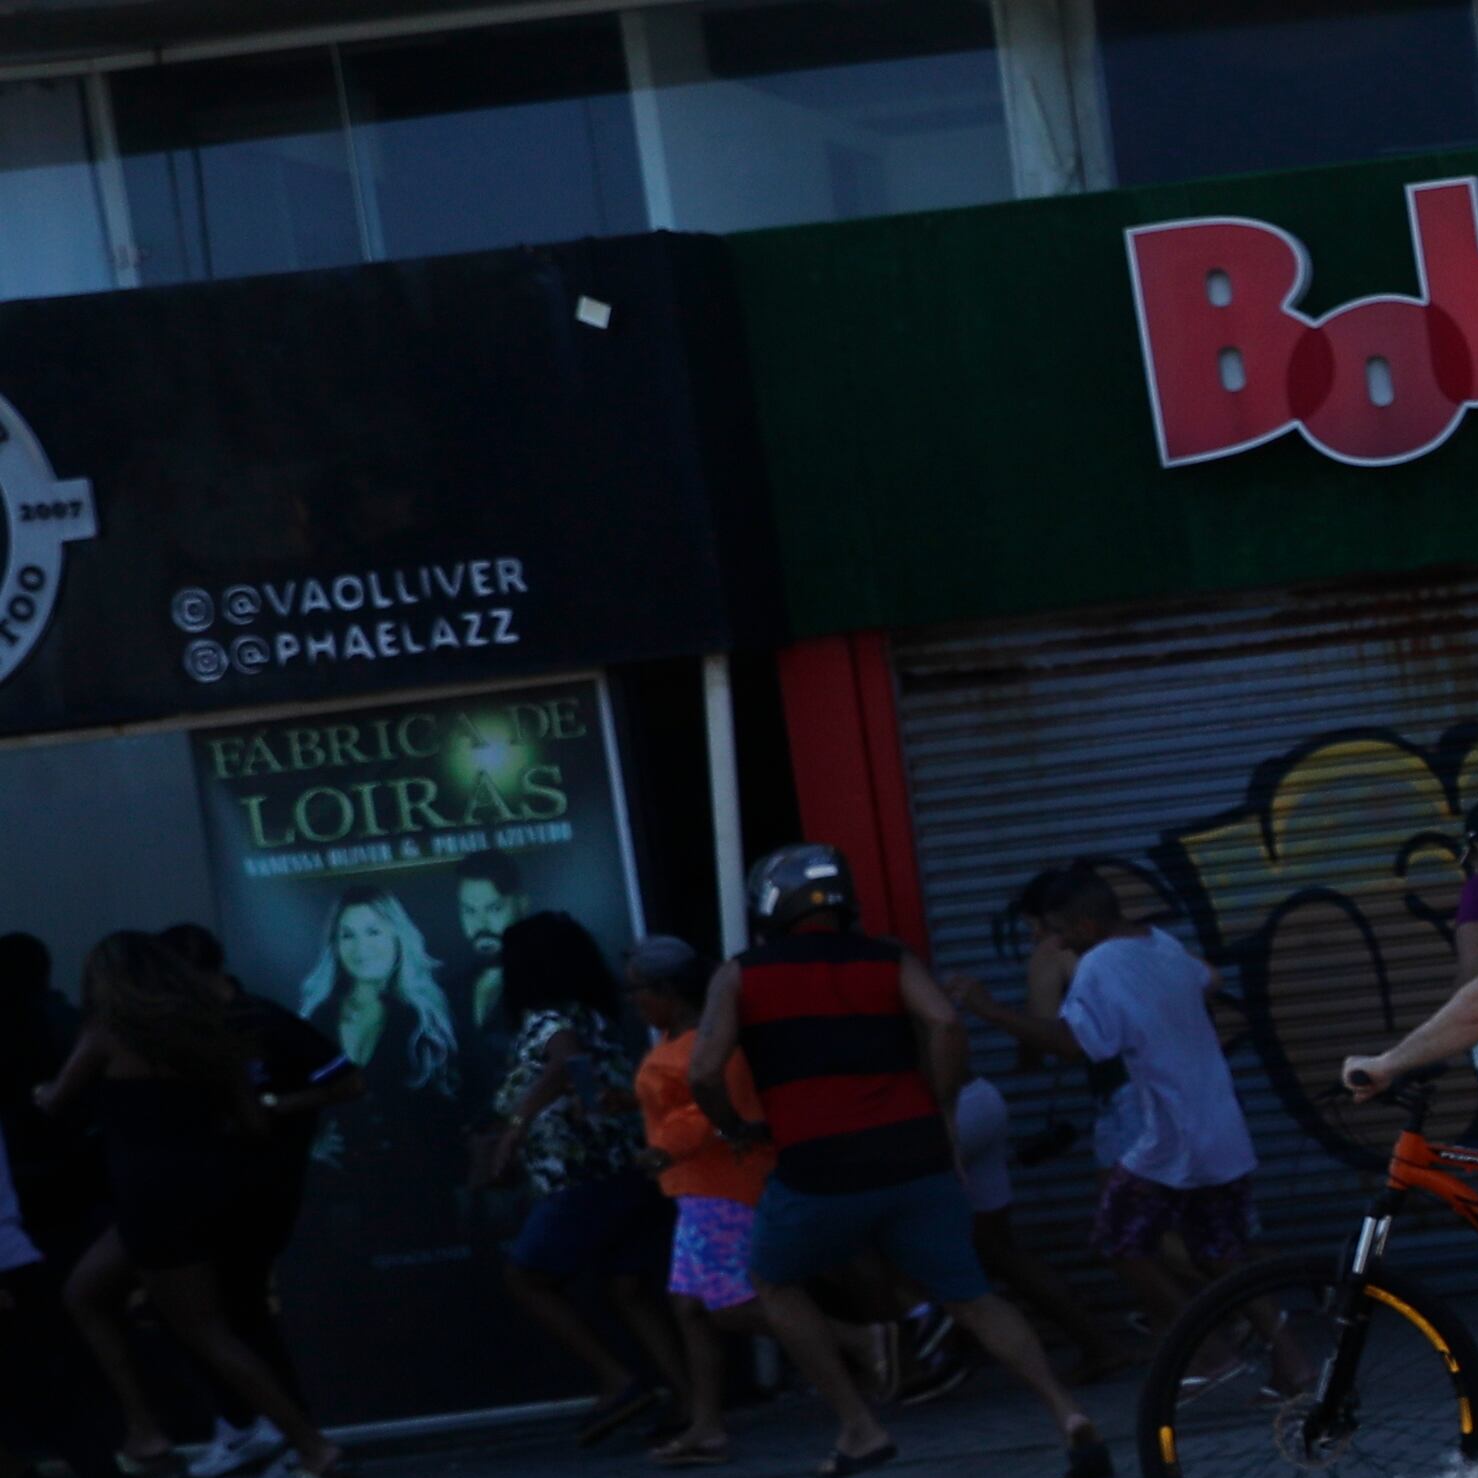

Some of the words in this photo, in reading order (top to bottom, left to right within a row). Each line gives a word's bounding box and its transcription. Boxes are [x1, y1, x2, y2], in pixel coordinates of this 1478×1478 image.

[20, 501, 83, 522] 2007
[506, 696, 588, 746] DE
[242, 764, 570, 848] LOIRAS
